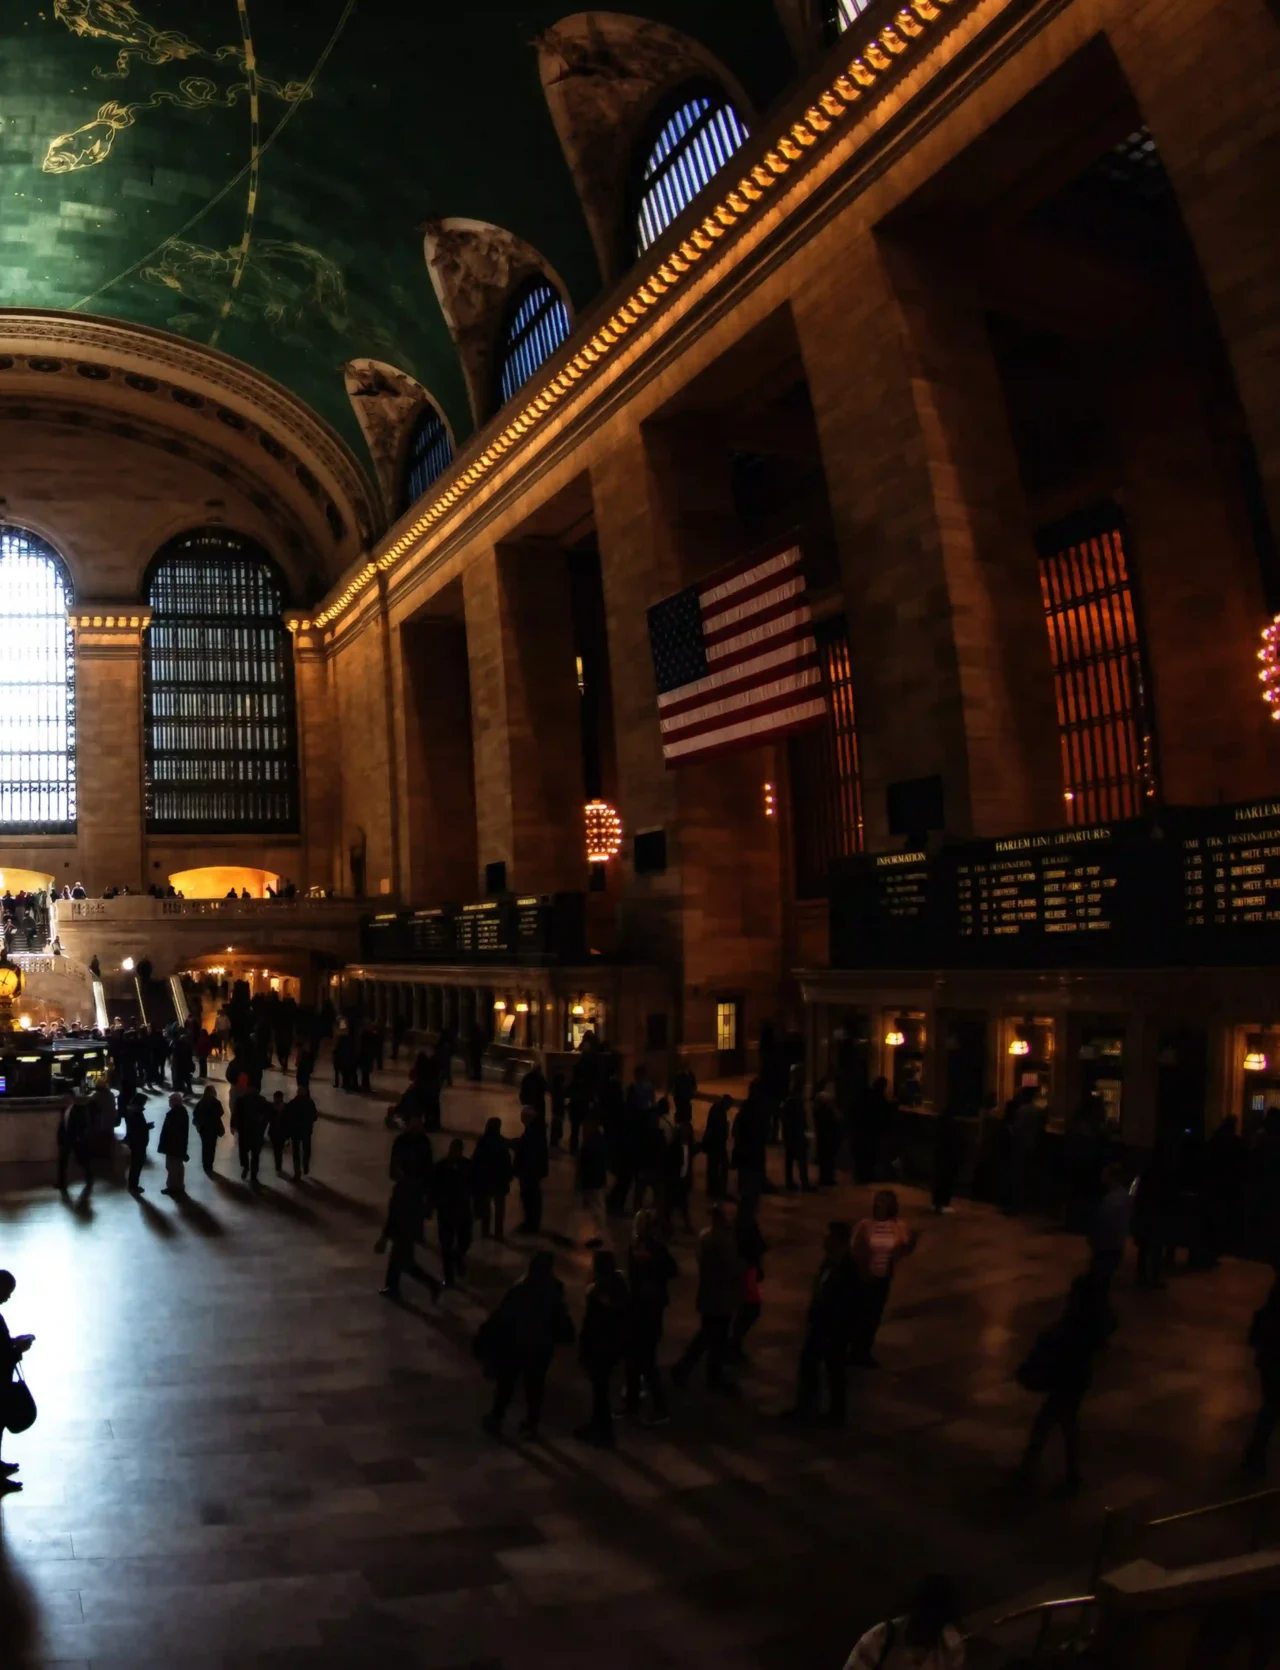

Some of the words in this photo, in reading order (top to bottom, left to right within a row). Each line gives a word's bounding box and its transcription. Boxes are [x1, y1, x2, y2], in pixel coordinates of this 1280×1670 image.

[995, 838, 1031, 852] HARLEM
[1032, 835, 1054, 847] LINE
[1055, 828, 1111, 845] DEPARTURES
[876, 852, 927, 866] INFORMATION
